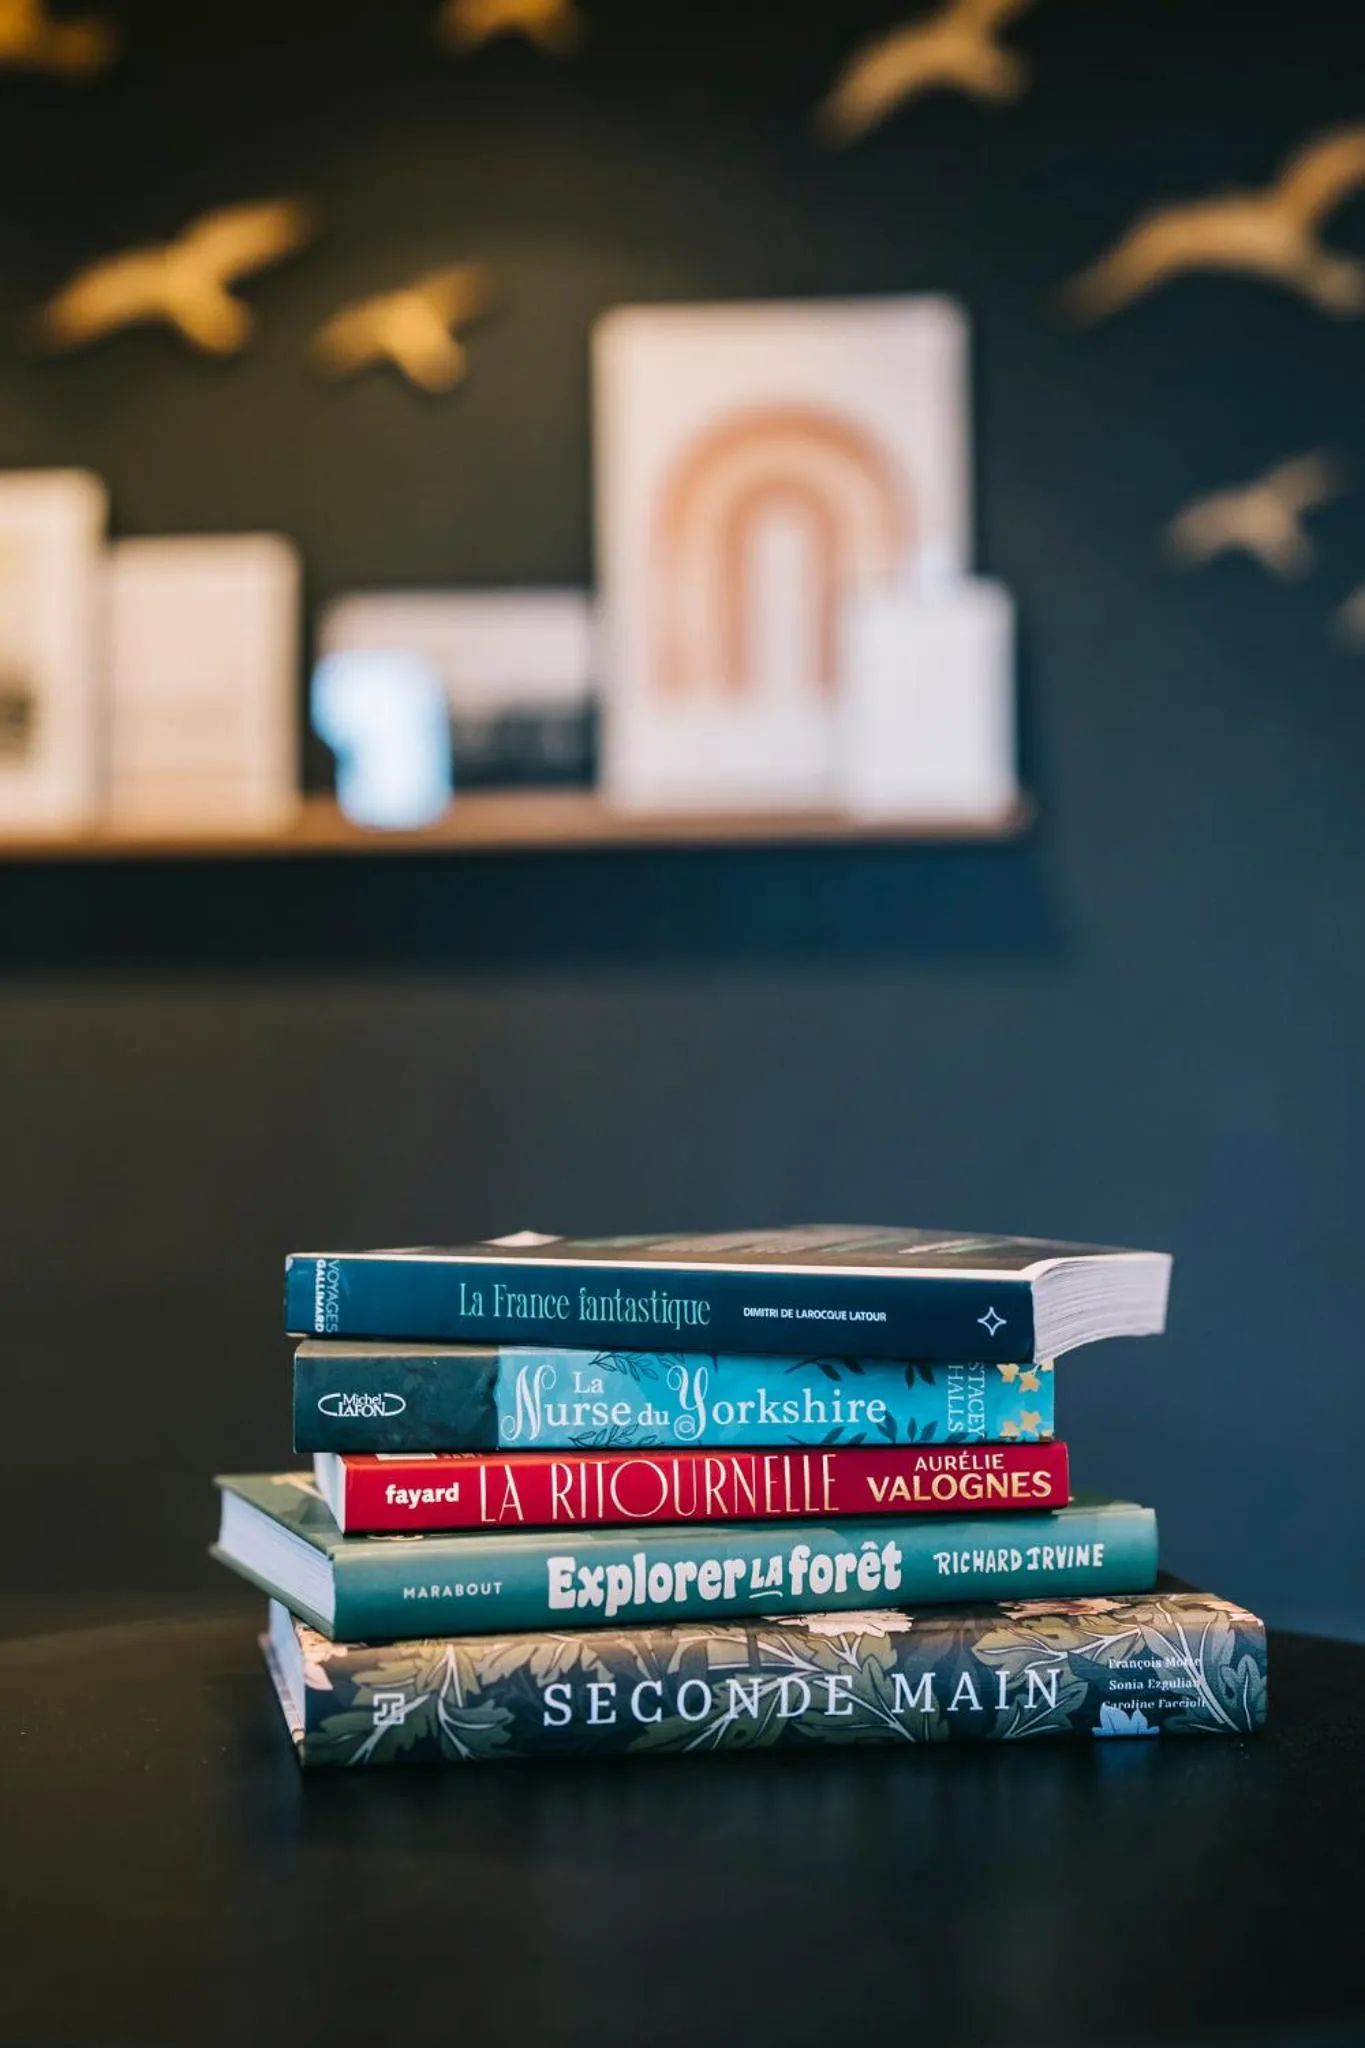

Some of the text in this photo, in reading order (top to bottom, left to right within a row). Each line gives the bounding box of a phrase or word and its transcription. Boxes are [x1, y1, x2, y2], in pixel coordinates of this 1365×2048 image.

[325, 1259, 340, 1333] VOYAGES
[459, 1283, 712, 1330] La France fantastique
[743, 1306, 887, 1322] DIMITRI DE LAROCQUE LATOUR
[342, 1393, 382, 1406] Michel
[572, 1372, 605, 1395] La
[947, 1364, 965, 1432] HALLS
[338, 1401, 386, 1418] LAFON
[501, 1364, 888, 1441] Nurse du Yorkshire
[915, 1450, 1005, 1472] AURÉLIE
[385, 1454, 840, 1522] fayard LA RITOURNELLE
[867, 1470, 1053, 1502] VALOGNES
[403, 1541, 1105, 1617] MARABOUT Explorer LA forêt RICHARD IRVINE
[1108, 1657, 1162, 1671] François
[543, 1668, 1061, 1727] SECONDE MAIN
[1108, 1678, 1144, 1690] Sonia
